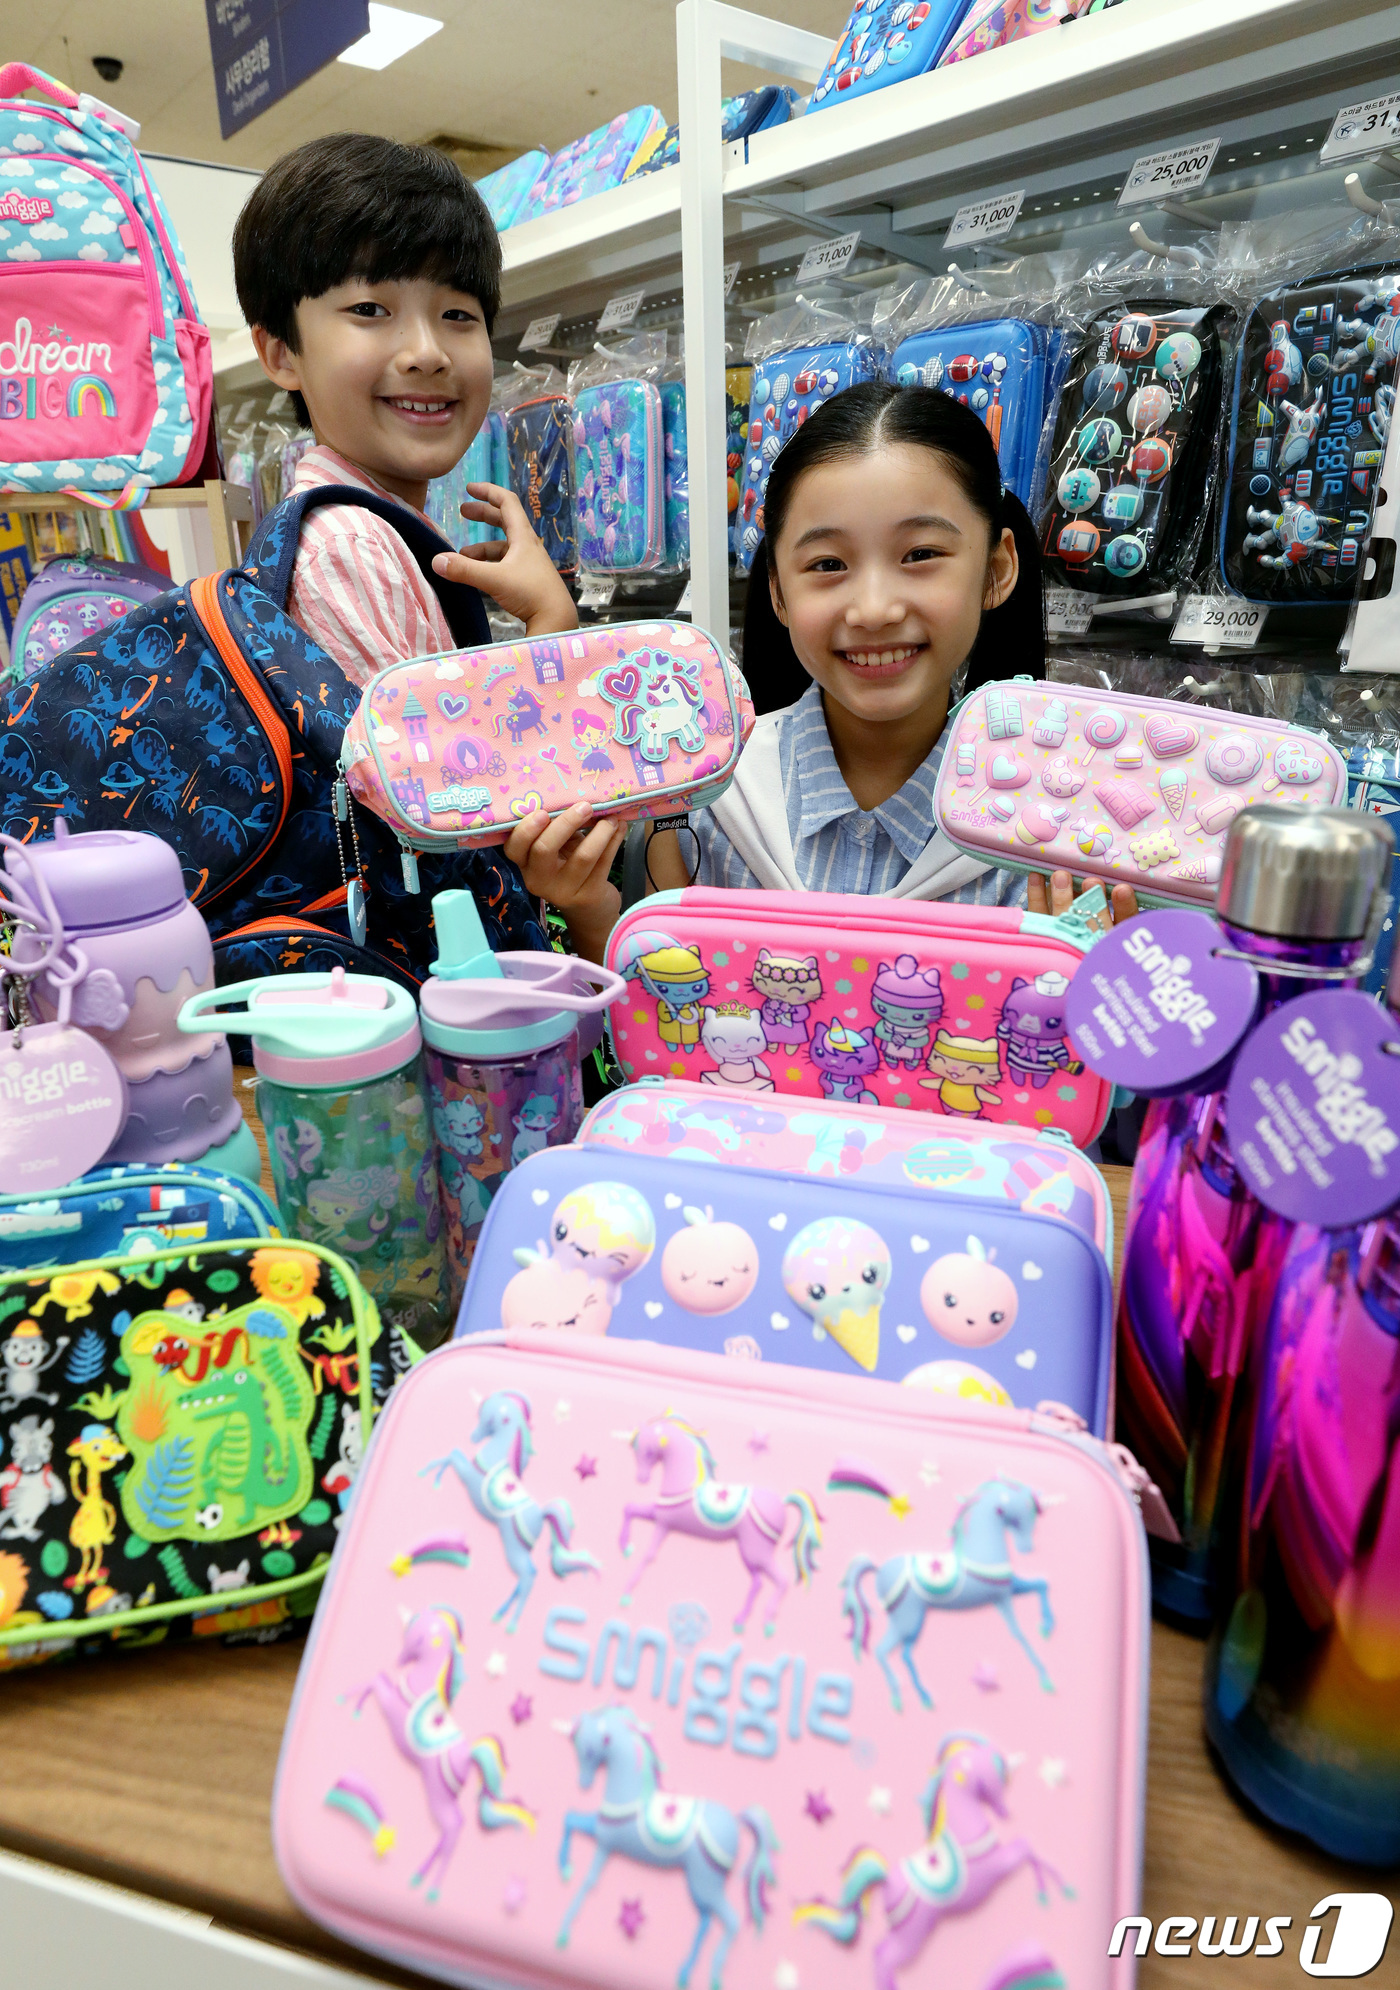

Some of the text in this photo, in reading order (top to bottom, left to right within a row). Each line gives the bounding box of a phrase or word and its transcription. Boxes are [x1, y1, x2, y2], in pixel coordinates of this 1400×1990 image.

[1150, 154, 1209, 182] 25,000
[969, 204, 1015, 228] 31,000
[816, 244, 852, 265] 31,000
[0, 317, 112, 376] dream
[0, 376, 63, 420] BIG
[1315, 373, 1362, 496] smiggle
[1203, 611, 1259, 628] 29,000
[431, 786, 489, 808] smiggle
[950, 808, 998, 828] smiggle
[1122, 927, 1217, 1036] smiggle
[1280, 1016, 1399, 1164] smiggle
[66, 1097, 112, 1115] bottle
[538, 1602, 854, 1759] smiggle
